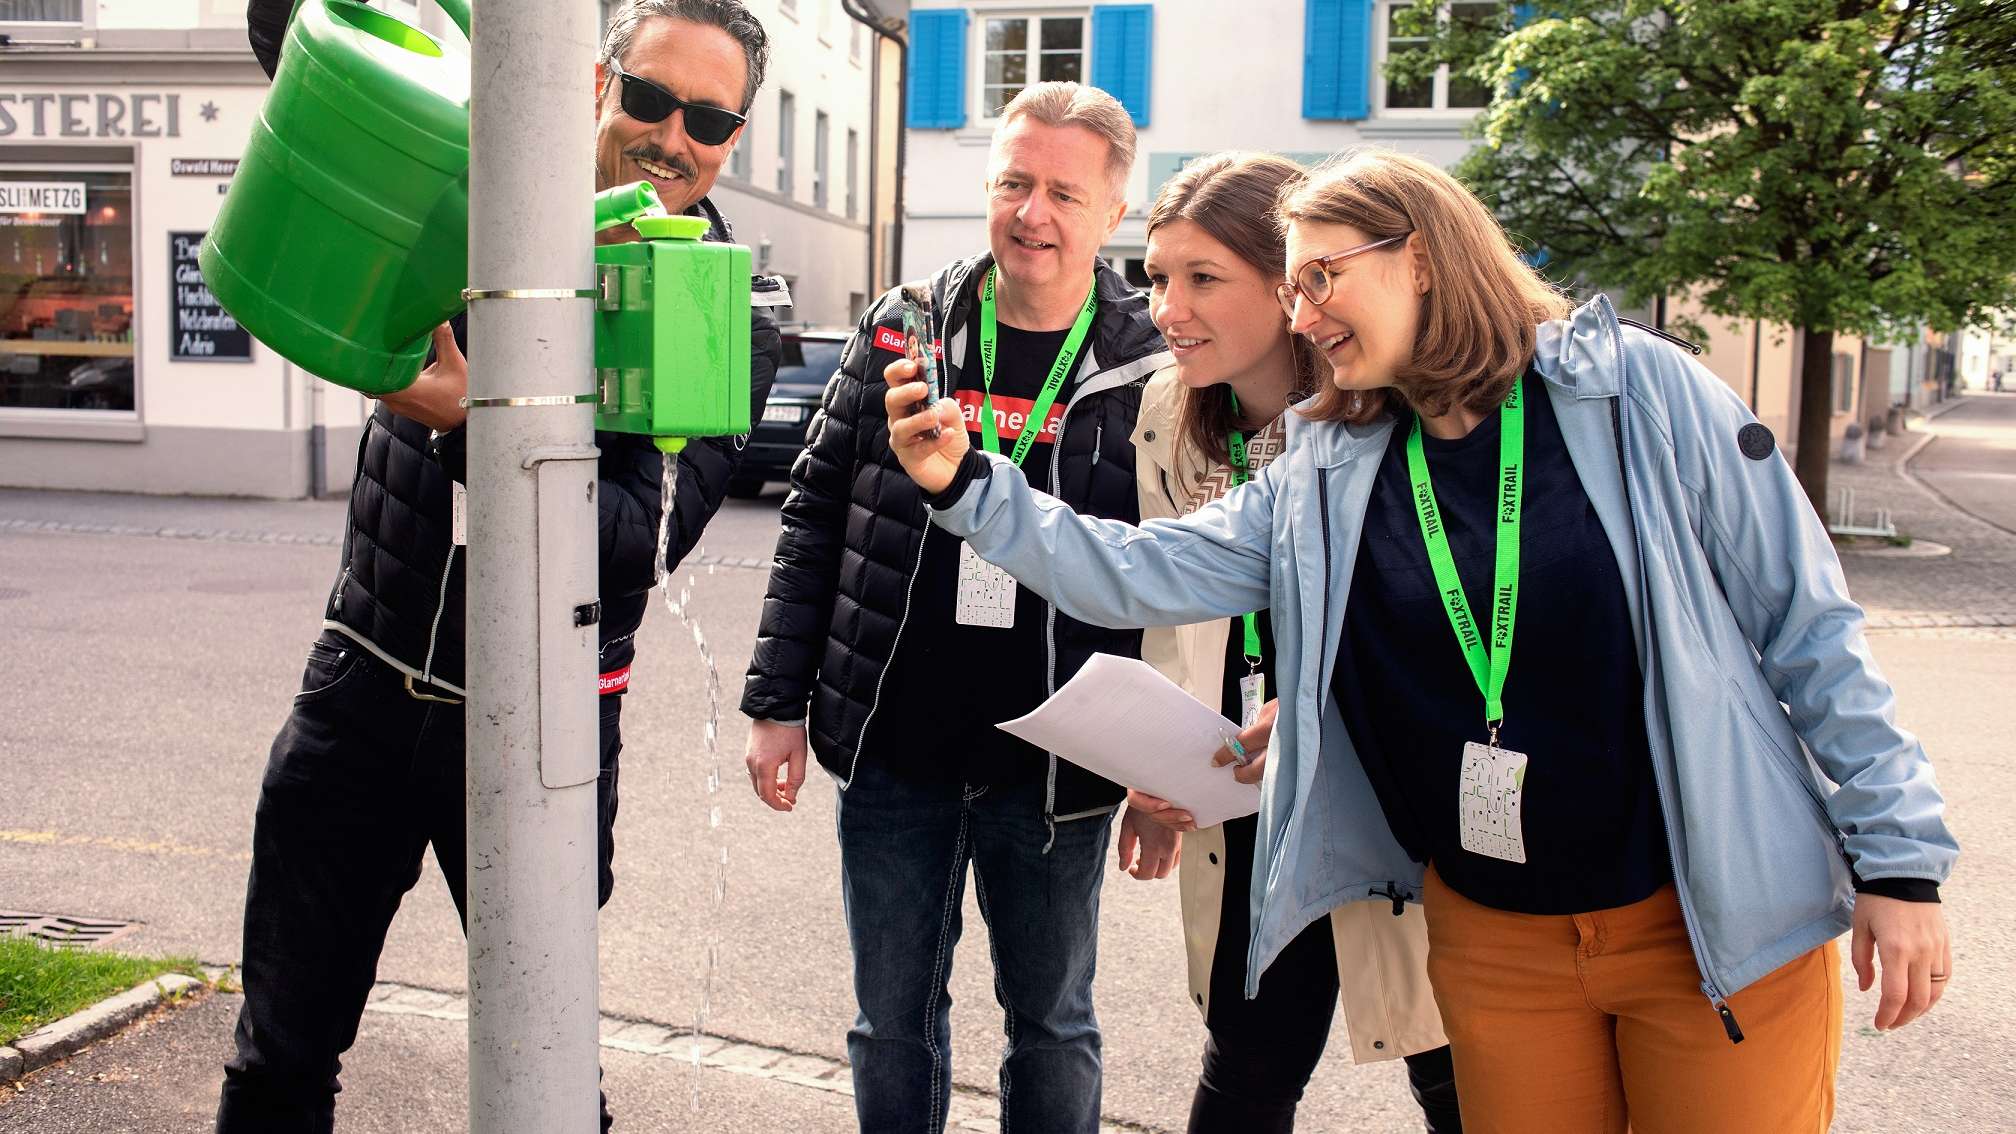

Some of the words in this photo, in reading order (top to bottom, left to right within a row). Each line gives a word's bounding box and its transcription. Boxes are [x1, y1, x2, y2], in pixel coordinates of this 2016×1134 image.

[29, 188, 81, 208] METZG
[1046, 349, 1073, 391] FOXTRAIL
[1416, 481, 1440, 539] FOXTRAIL
[1501, 463, 1518, 524] FOXTRAIL
[1446, 588, 1478, 652] FOXTRAIL
[1495, 583, 1513, 649] FOXTRAIL
